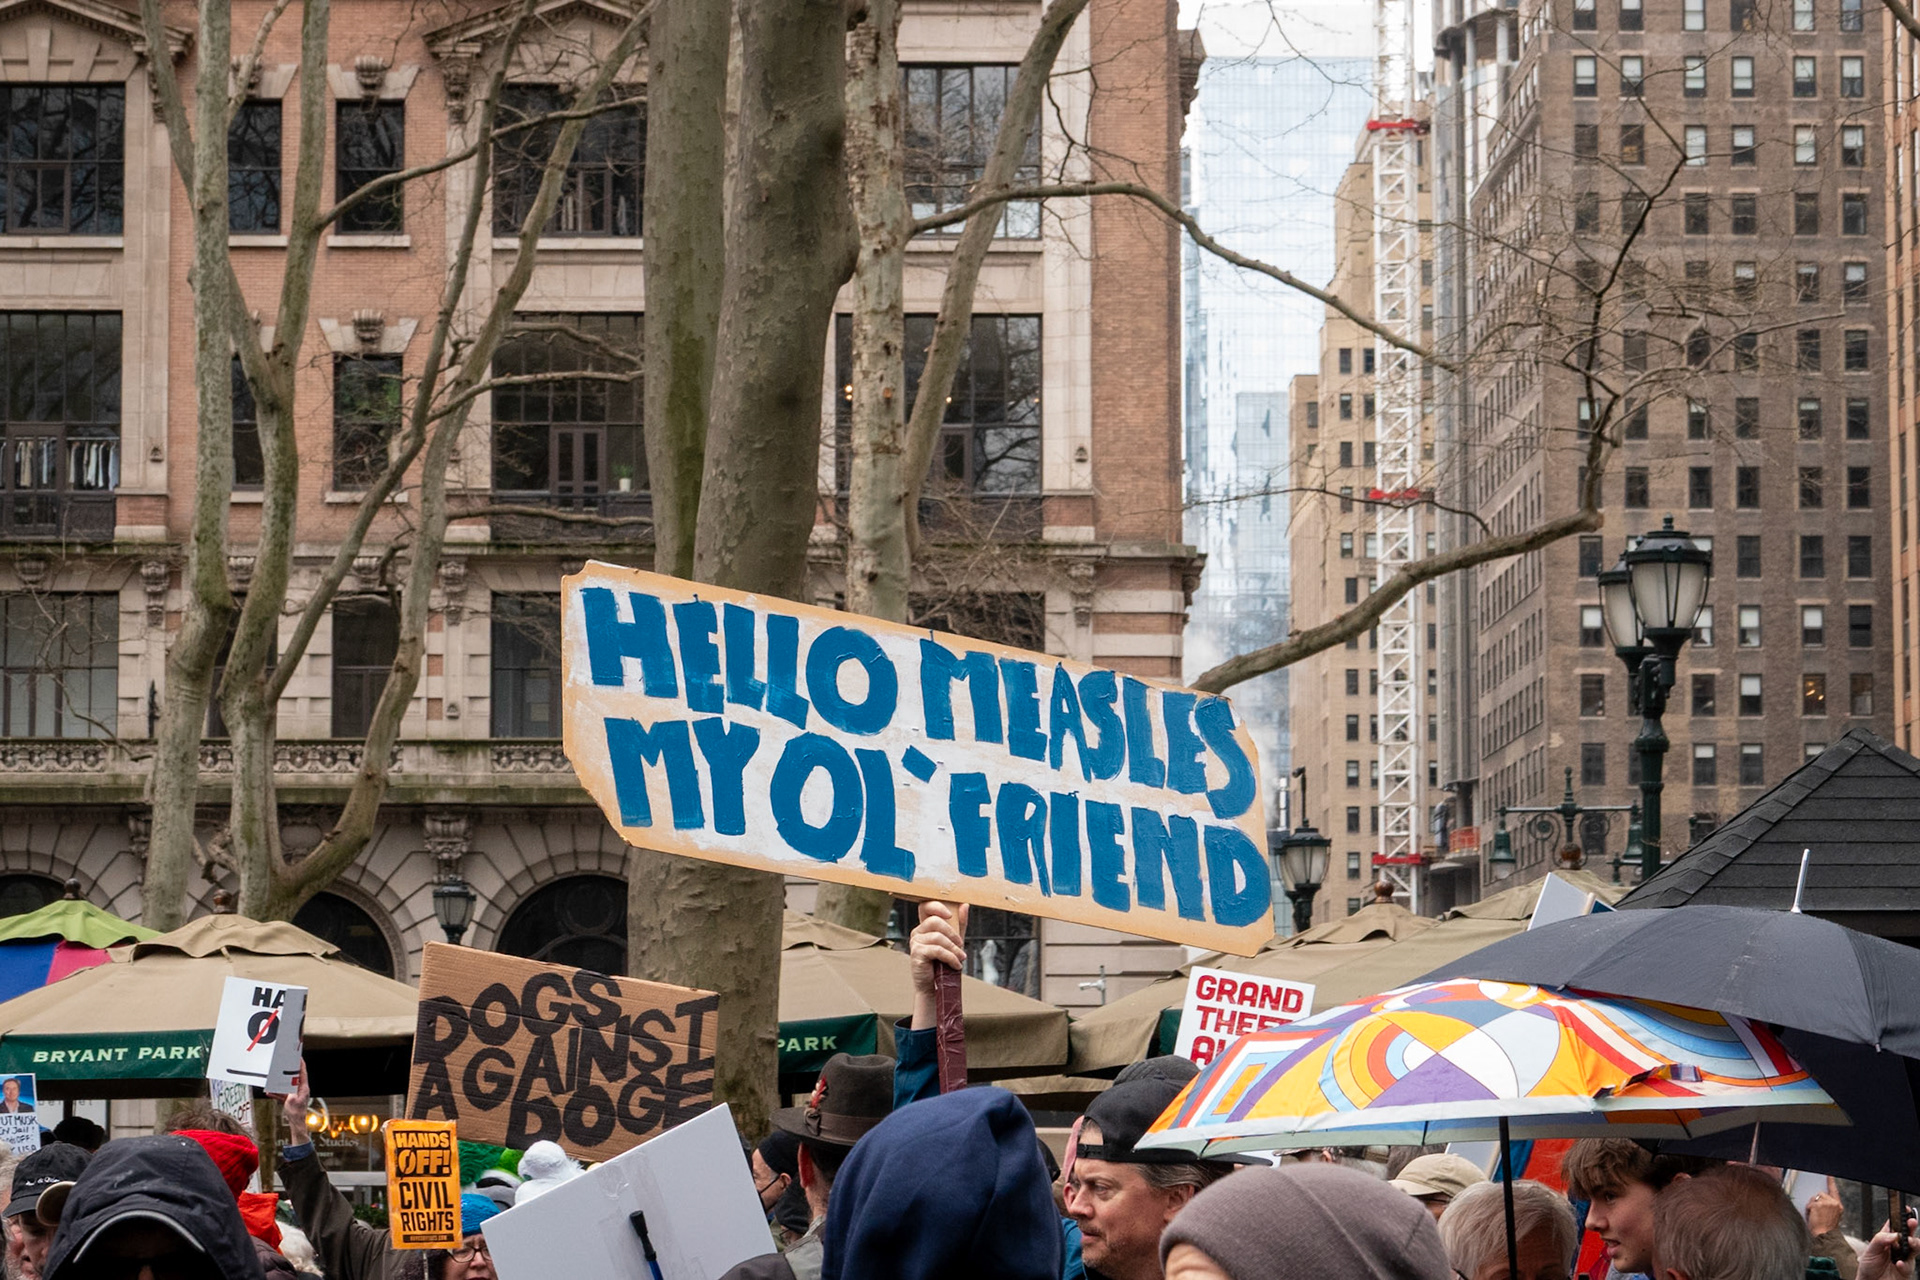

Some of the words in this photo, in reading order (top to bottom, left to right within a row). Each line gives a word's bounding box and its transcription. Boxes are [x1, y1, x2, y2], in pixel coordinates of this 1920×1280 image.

[579, 587, 898, 736] HELLO
[920, 634, 1256, 819] MEASLES
[604, 717, 760, 835] MY
[770, 731, 936, 882] OL'
[949, 772, 1271, 927] FRIEND
[252, 987, 286, 1008] HA
[1196, 975, 1304, 1013] GRAND
[413, 969, 622, 1064] DOGS
[33, 1048, 128, 1063] BRYANT
[138, 1045, 201, 1060] PARK
[413, 994, 720, 1119] AGAINST
[506, 1056, 715, 1149] DOGE
[395, 1132, 450, 1148] HANDS
[398, 1149, 452, 1175] OFF!
[399, 1181, 454, 1209] CIVIL
[401, 1211, 454, 1231] RIGHTS
